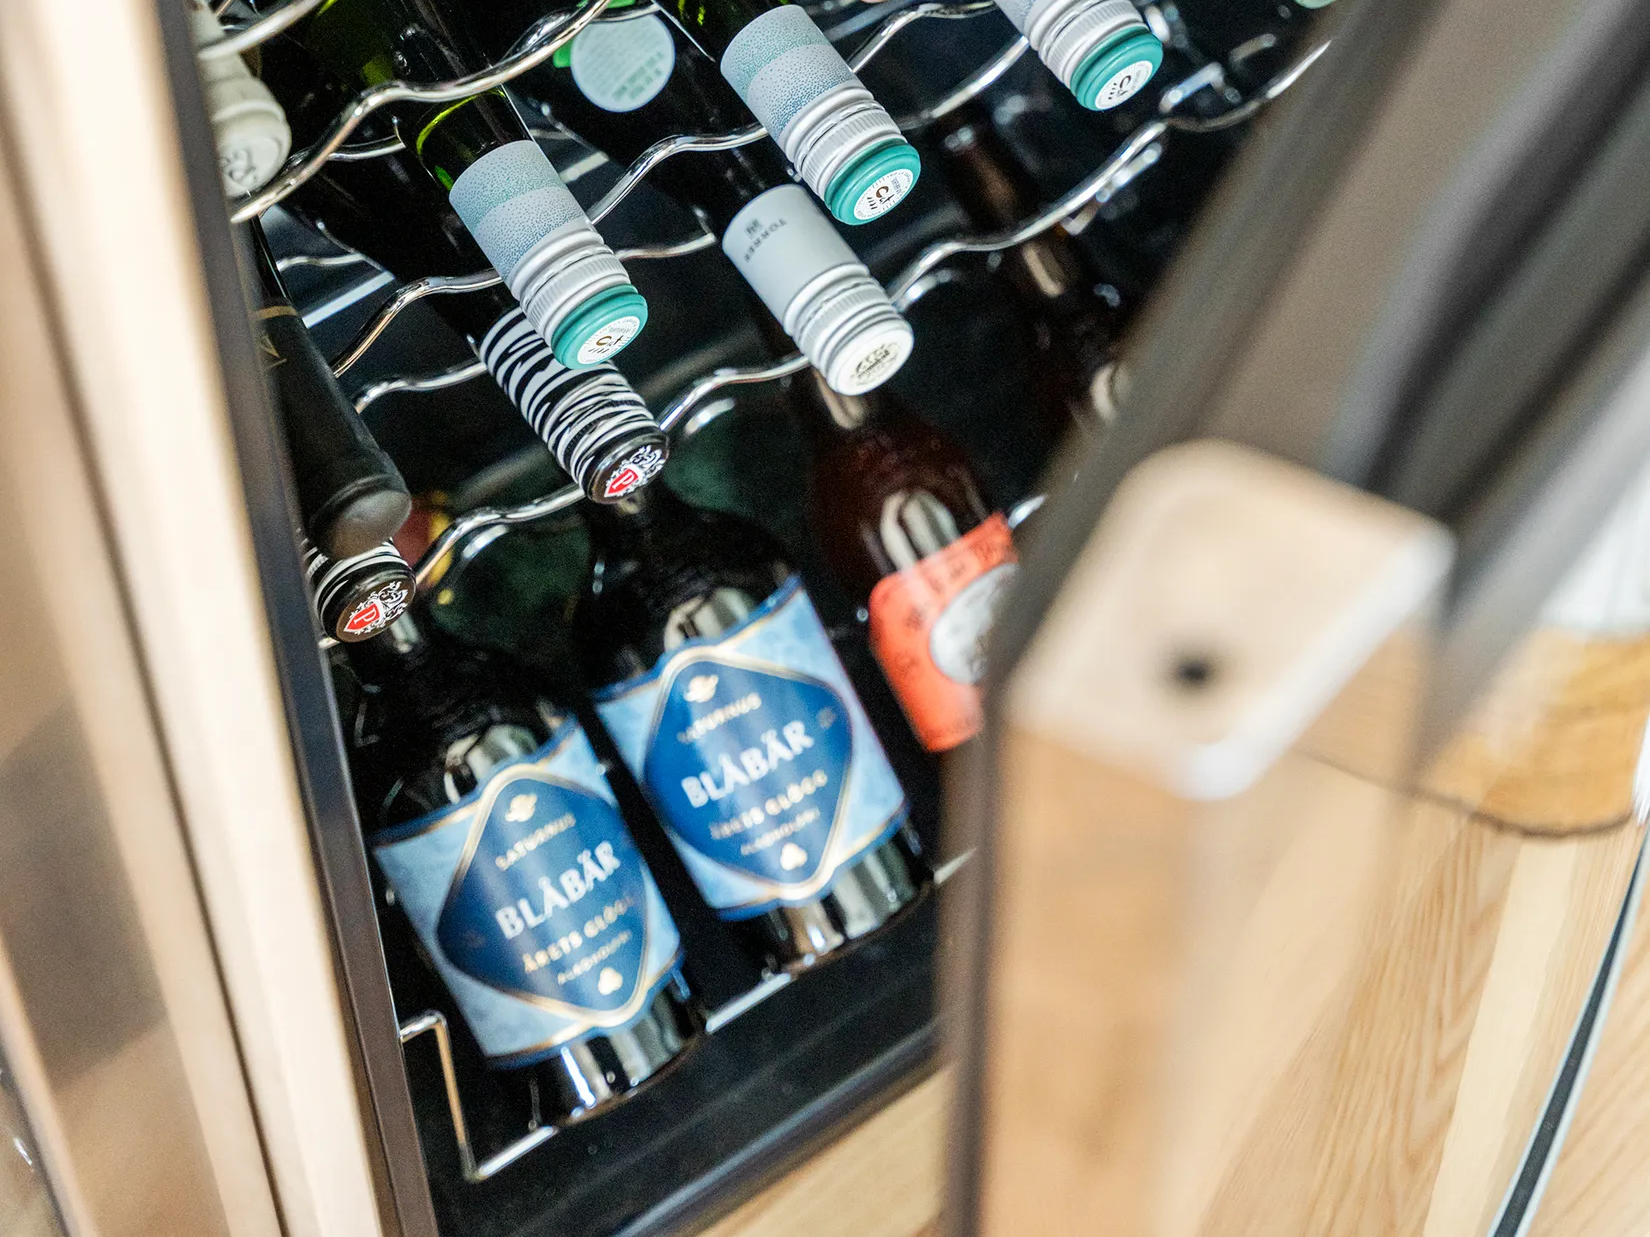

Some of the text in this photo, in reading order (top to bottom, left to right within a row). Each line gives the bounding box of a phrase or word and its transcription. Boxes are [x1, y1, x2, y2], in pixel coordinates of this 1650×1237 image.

[353, 607, 377, 625] P
[681, 720, 815, 809] BLÅBÄR
[495, 813, 576, 871] SATURNUS
[495, 840, 621, 940] BLÅBÄR
[523, 930, 583, 974] ÅRETS
